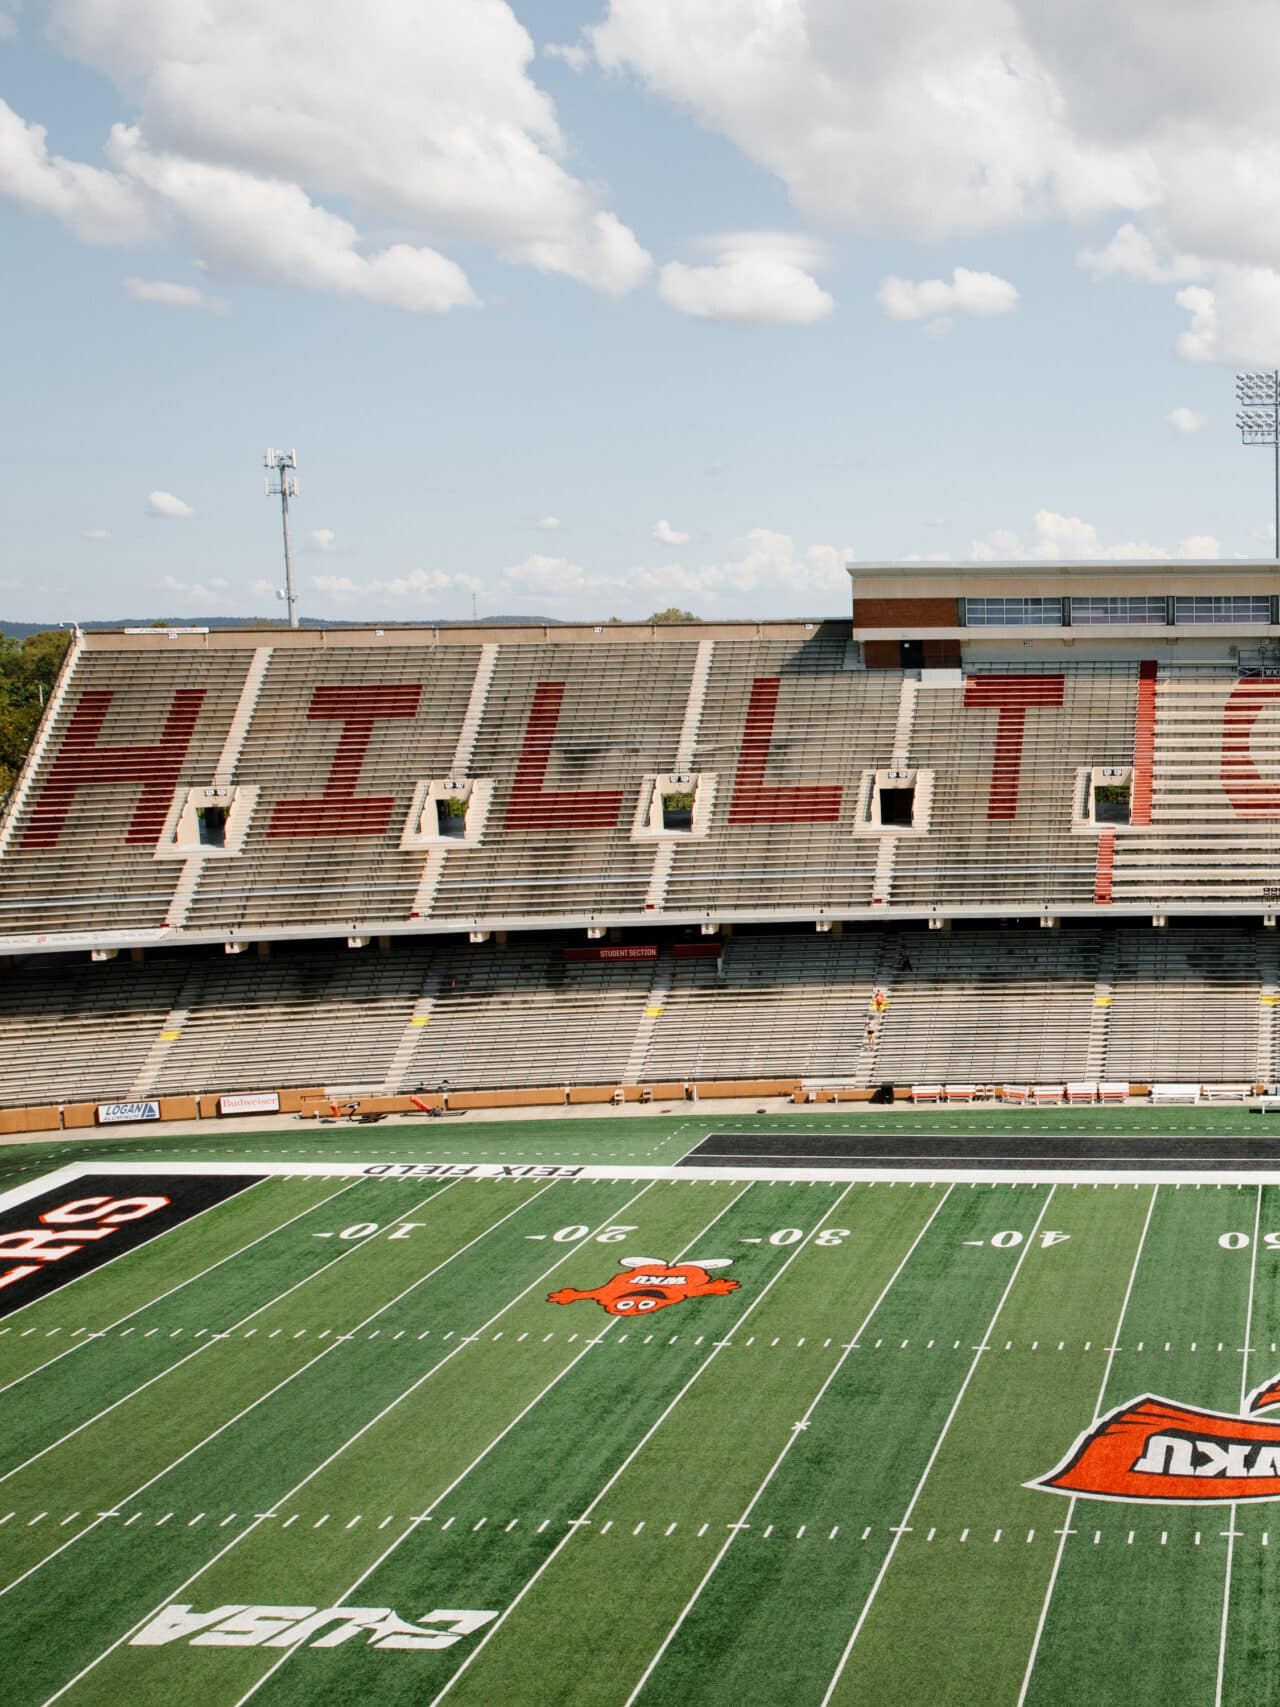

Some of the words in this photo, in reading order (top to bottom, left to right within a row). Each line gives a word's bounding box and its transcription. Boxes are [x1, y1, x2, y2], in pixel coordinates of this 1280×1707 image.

[600, 949, 628, 958] STUDENT
[628, 948, 657, 957] SECTION
[222, 1096, 277, 1108] Budweiser
[105, 1103, 143, 1116] LOGAN
[363, 1164, 480, 1176] FIELD
[494, 1165, 585, 1177] FEIX
[339, 1222, 427, 1240] 10
[552, 1225, 639, 1243] 20
[769, 1228, 851, 1246] 30
[991, 1231, 1071, 1248] 40
[628, 1275, 688, 1285] WKU
